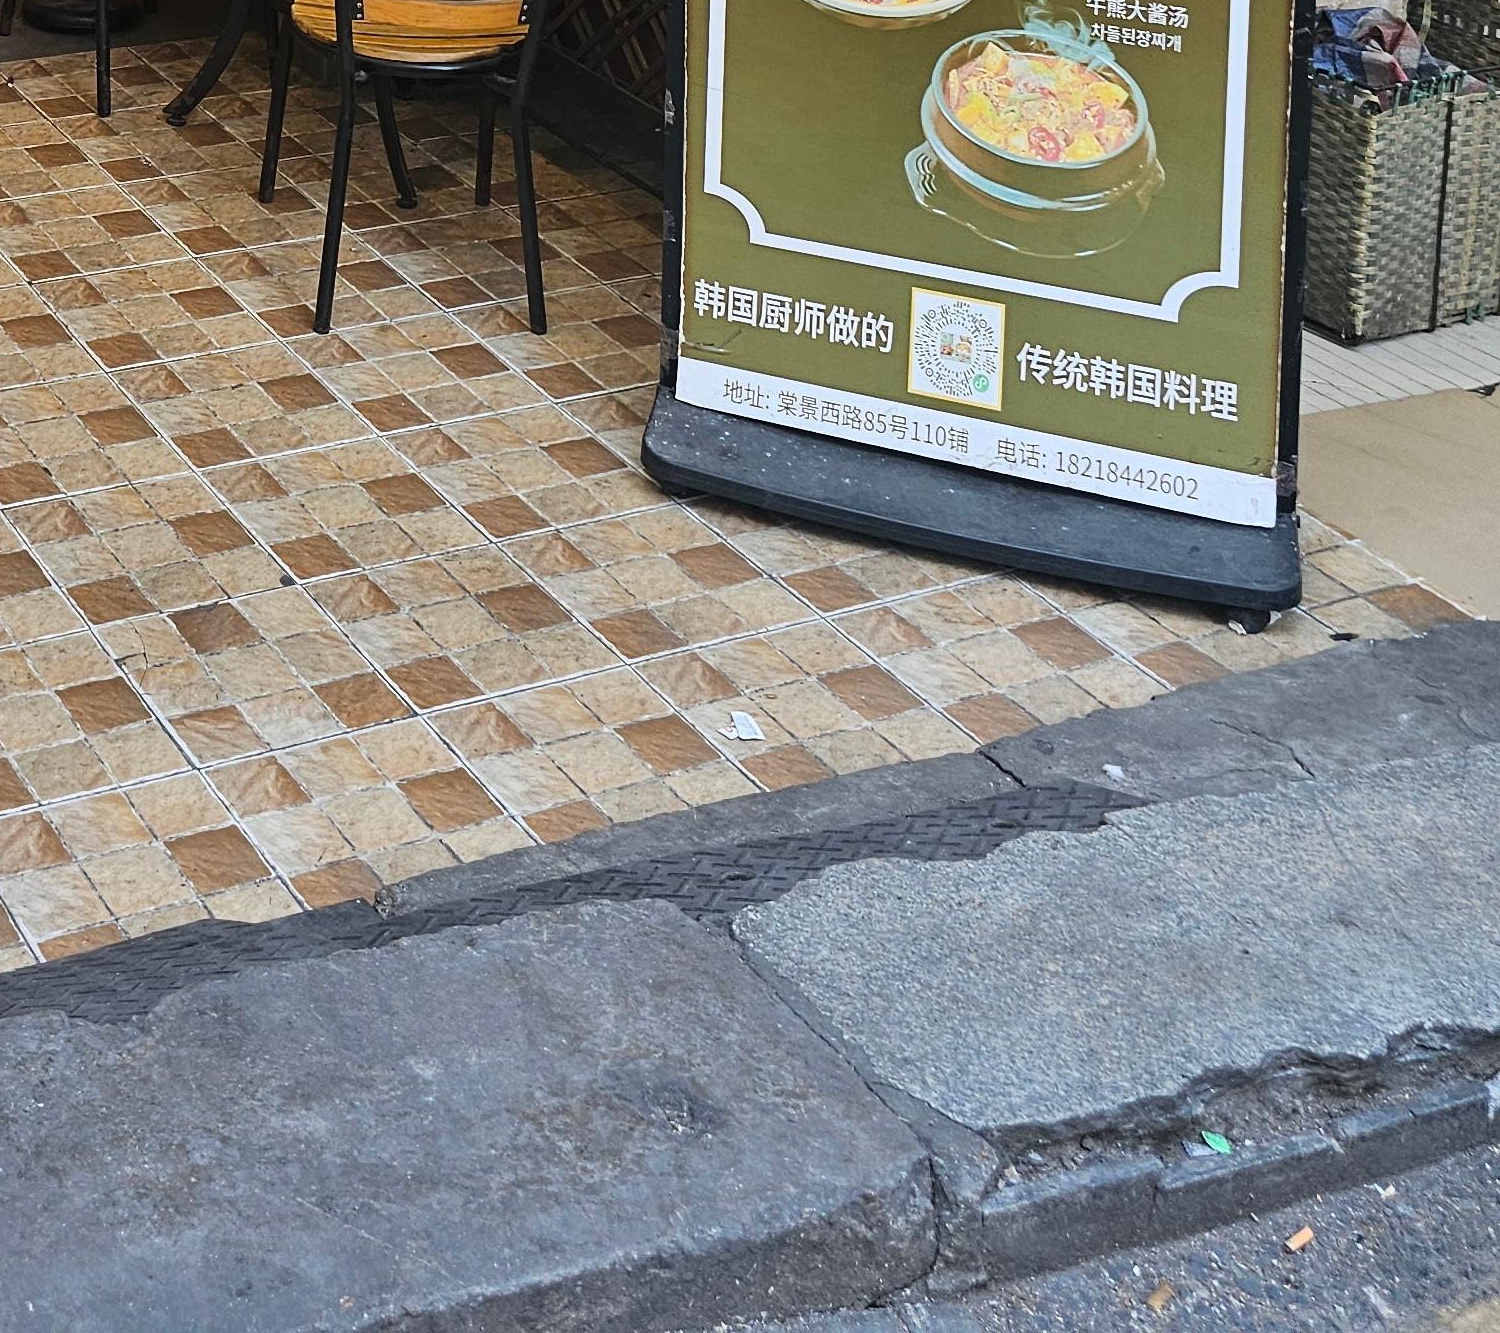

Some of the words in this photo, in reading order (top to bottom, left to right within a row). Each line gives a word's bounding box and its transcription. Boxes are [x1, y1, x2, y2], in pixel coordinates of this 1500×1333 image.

[1090, 22, 1182, 53] 차돌된장찌개
[693, 279, 895, 354] 韩国厨师做的
[1016, 342, 1239, 423] 传统韩国料理
[1055, 449, 1199, 502] 18218442602
